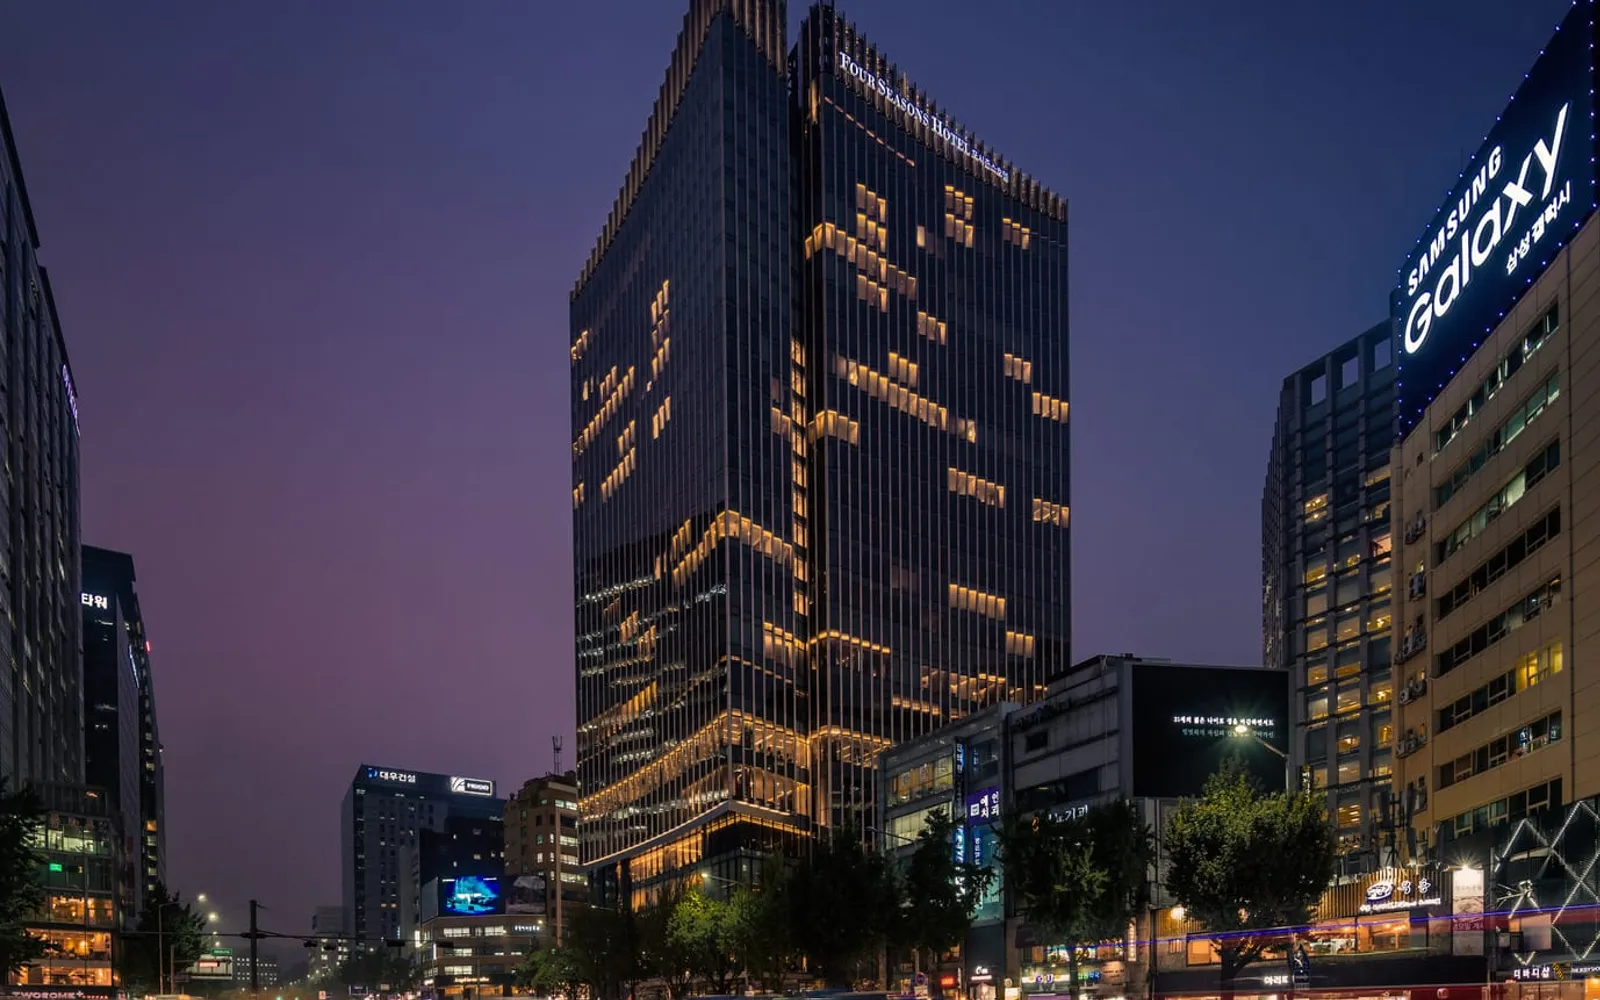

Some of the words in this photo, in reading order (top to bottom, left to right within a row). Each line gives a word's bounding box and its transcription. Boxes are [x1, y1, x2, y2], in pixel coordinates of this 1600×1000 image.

[839, 51, 876, 90] FOUR
[878, 78, 930, 127] SEASONS
[931, 115, 971, 156] HOTEL
[1404, 102, 1569, 354] Galaxy
[1408, 146, 1501, 296] SAMSUNG
[81, 592, 108, 609] 타워
[379, 770, 416, 783] 대우건설
